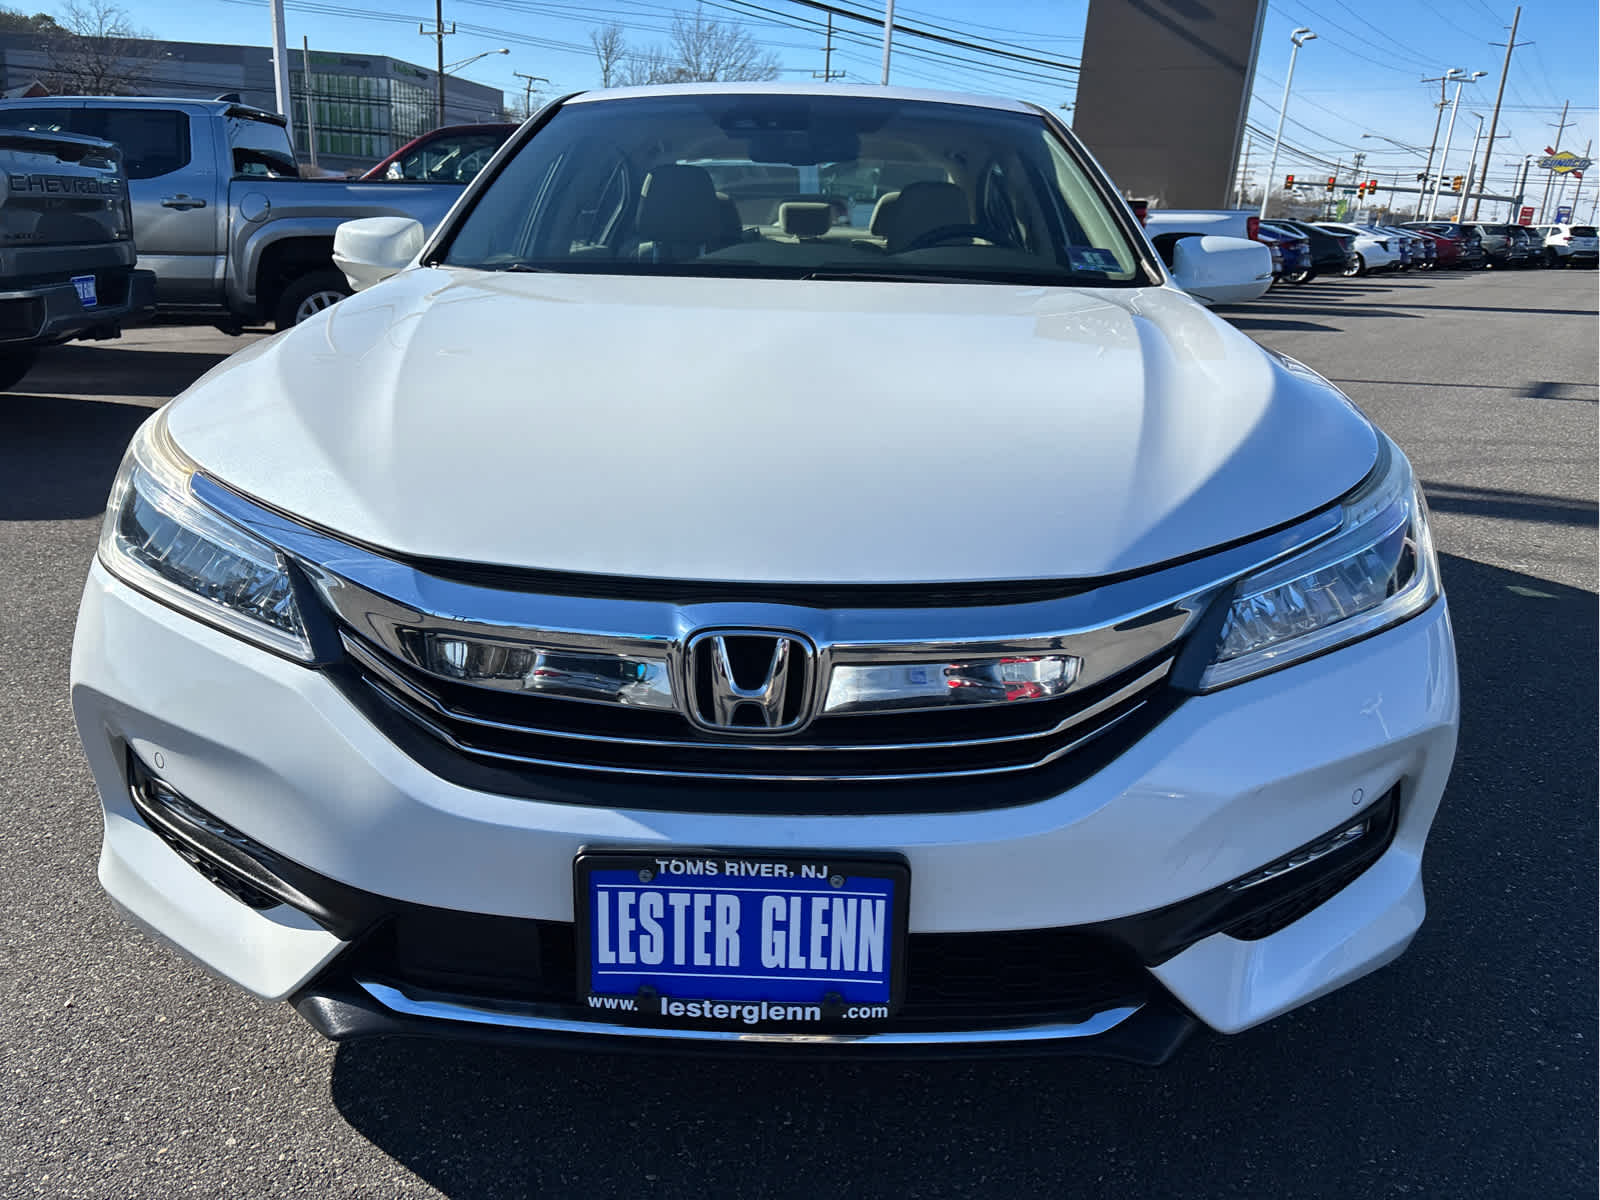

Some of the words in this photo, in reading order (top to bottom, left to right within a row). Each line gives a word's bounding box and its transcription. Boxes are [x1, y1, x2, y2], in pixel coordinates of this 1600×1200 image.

[656, 859, 719, 876] TOMS
[725, 862, 795, 878] RIVER,
[801, 864, 828, 879] NJ
[598, 891, 741, 967] LESTER
[761, 895, 886, 973] GLENN
[588, 996, 639, 1012] www.
[661, 997, 821, 1025] lesterglenn
[841, 1003, 889, 1019] .com
